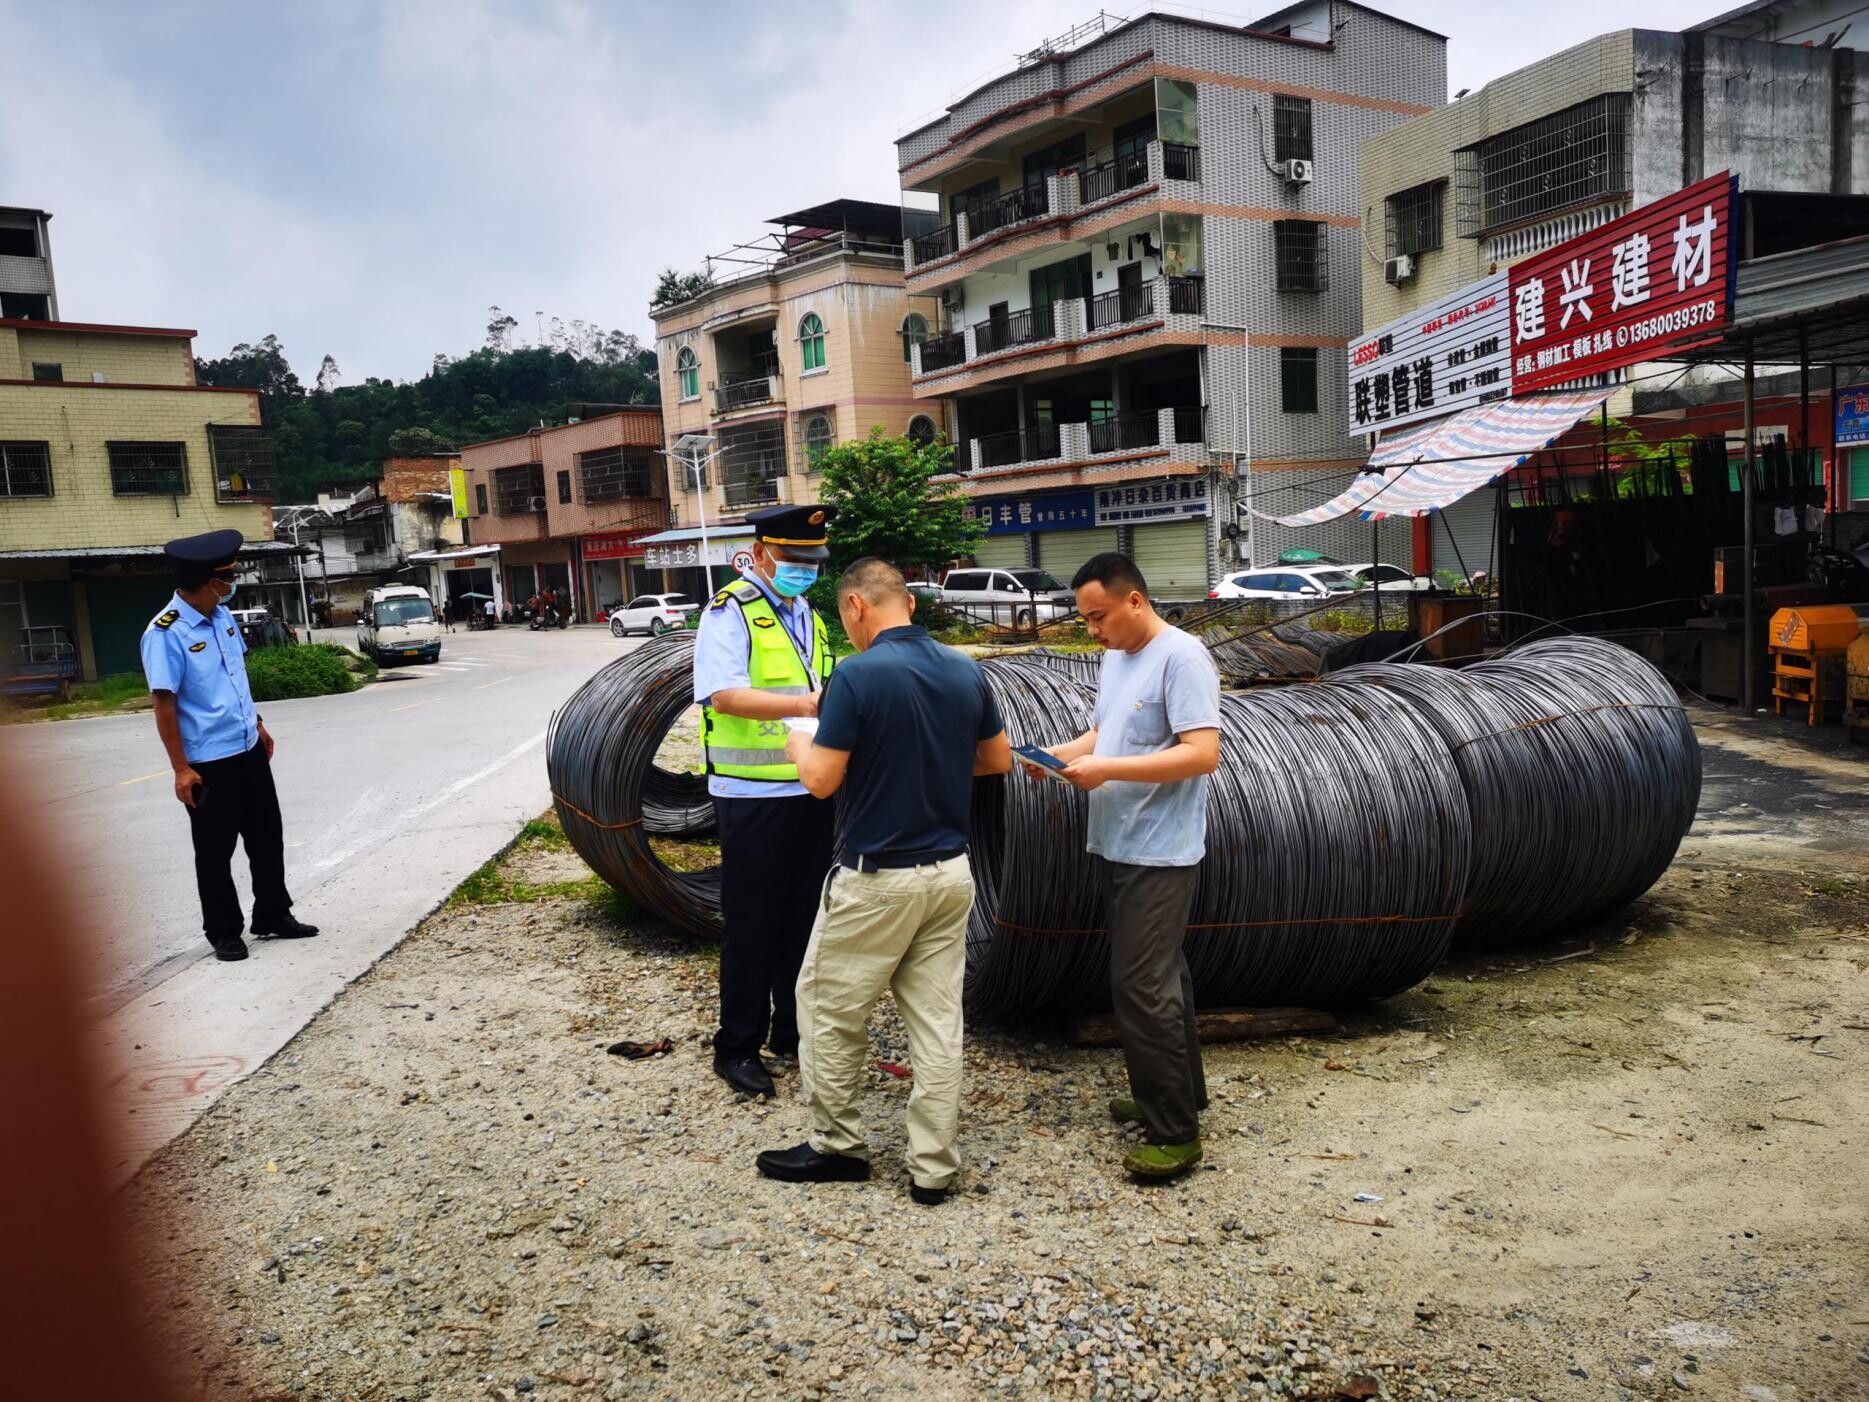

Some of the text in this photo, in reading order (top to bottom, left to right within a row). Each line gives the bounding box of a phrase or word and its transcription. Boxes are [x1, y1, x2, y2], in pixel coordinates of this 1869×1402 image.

[1515, 205, 1717, 345] 建兴建材
[1629, 299, 1716, 344] 13680039378
[1354, 355, 1435, 426] 联塑管道
[645, 543, 698, 567] 车站士多
[736, 557, 750, 569] 30
